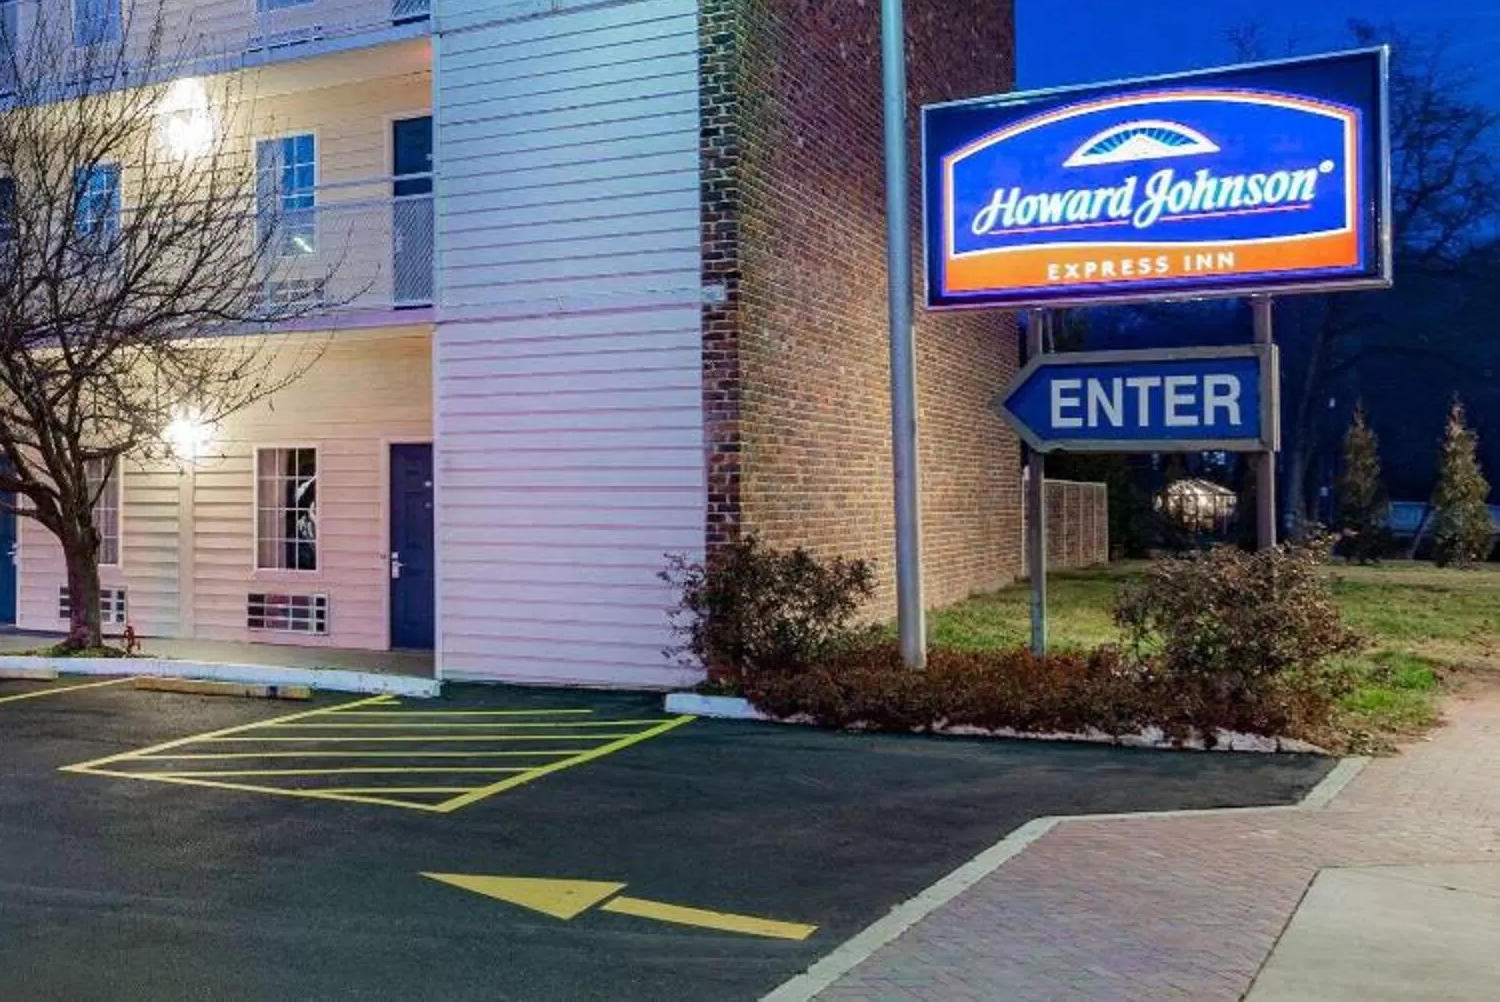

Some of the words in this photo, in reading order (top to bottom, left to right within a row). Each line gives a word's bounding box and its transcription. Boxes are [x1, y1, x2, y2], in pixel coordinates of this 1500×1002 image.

[972, 176, 1137, 234] Howard
[1047, 257, 1169, 280] EXPRESS
[1184, 252, 1236, 272] INN
[1051, 374, 1242, 428] ENTER
